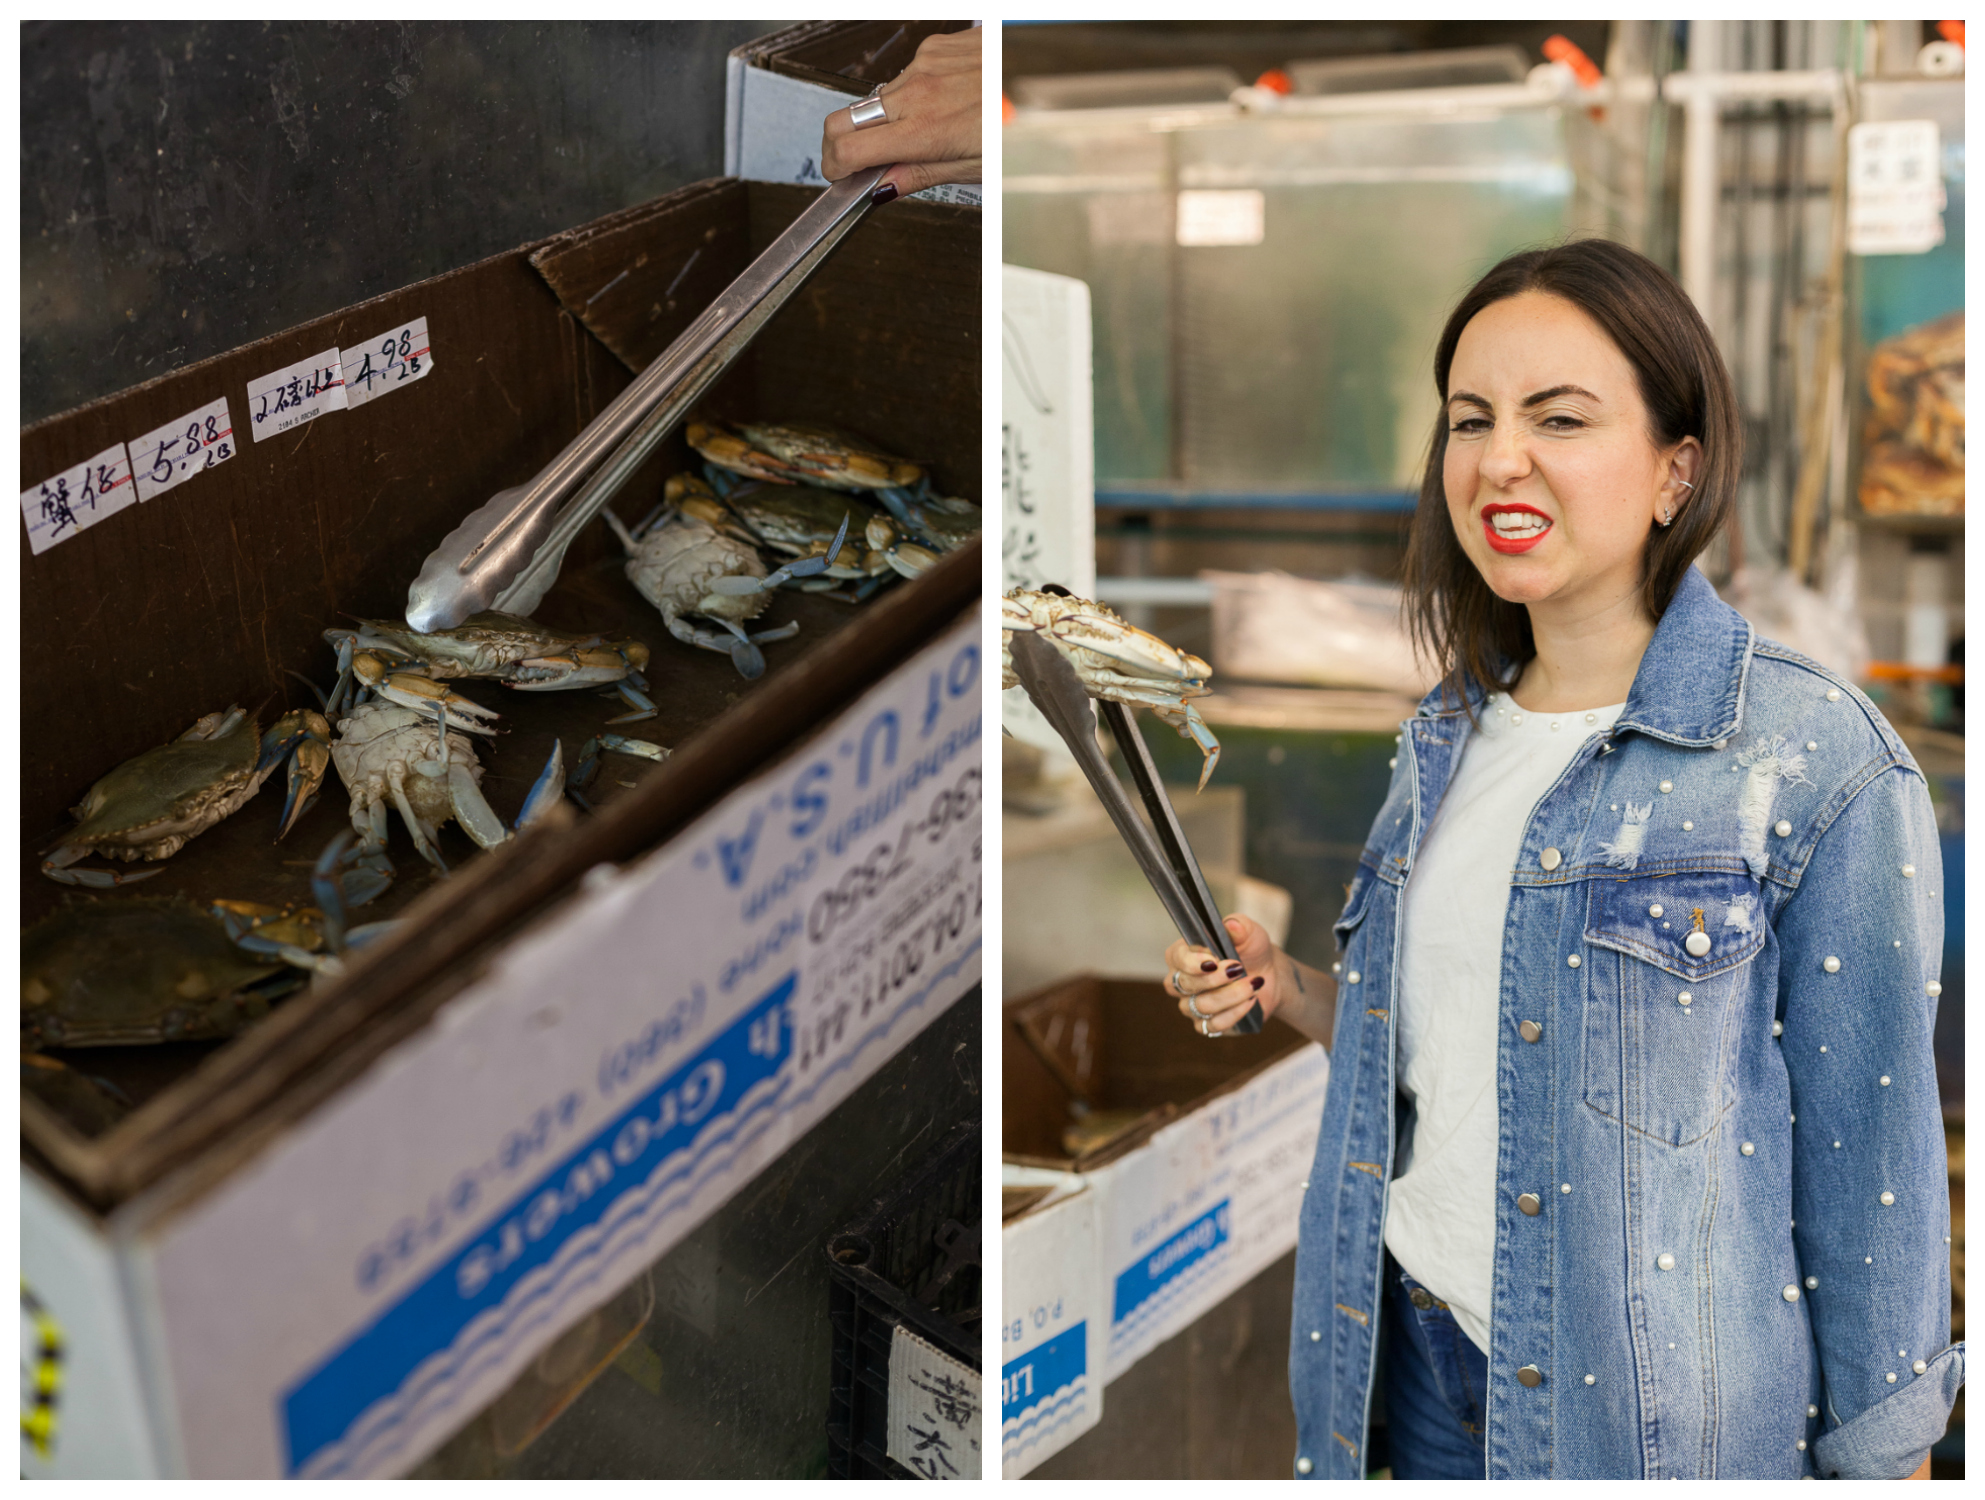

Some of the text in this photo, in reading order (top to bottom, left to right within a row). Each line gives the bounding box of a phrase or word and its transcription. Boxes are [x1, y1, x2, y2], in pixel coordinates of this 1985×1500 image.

[355, 329, 411, 391] 4.98
[151, 415, 218, 483] 5.88
[278, 419, 292, 431] 2104
[294, 416, 300, 425] S
[691, 708, 896, 890] U.S.A.
[806, 766, 982, 945] 36-7350
[454, 1055, 728, 1300] Growers
